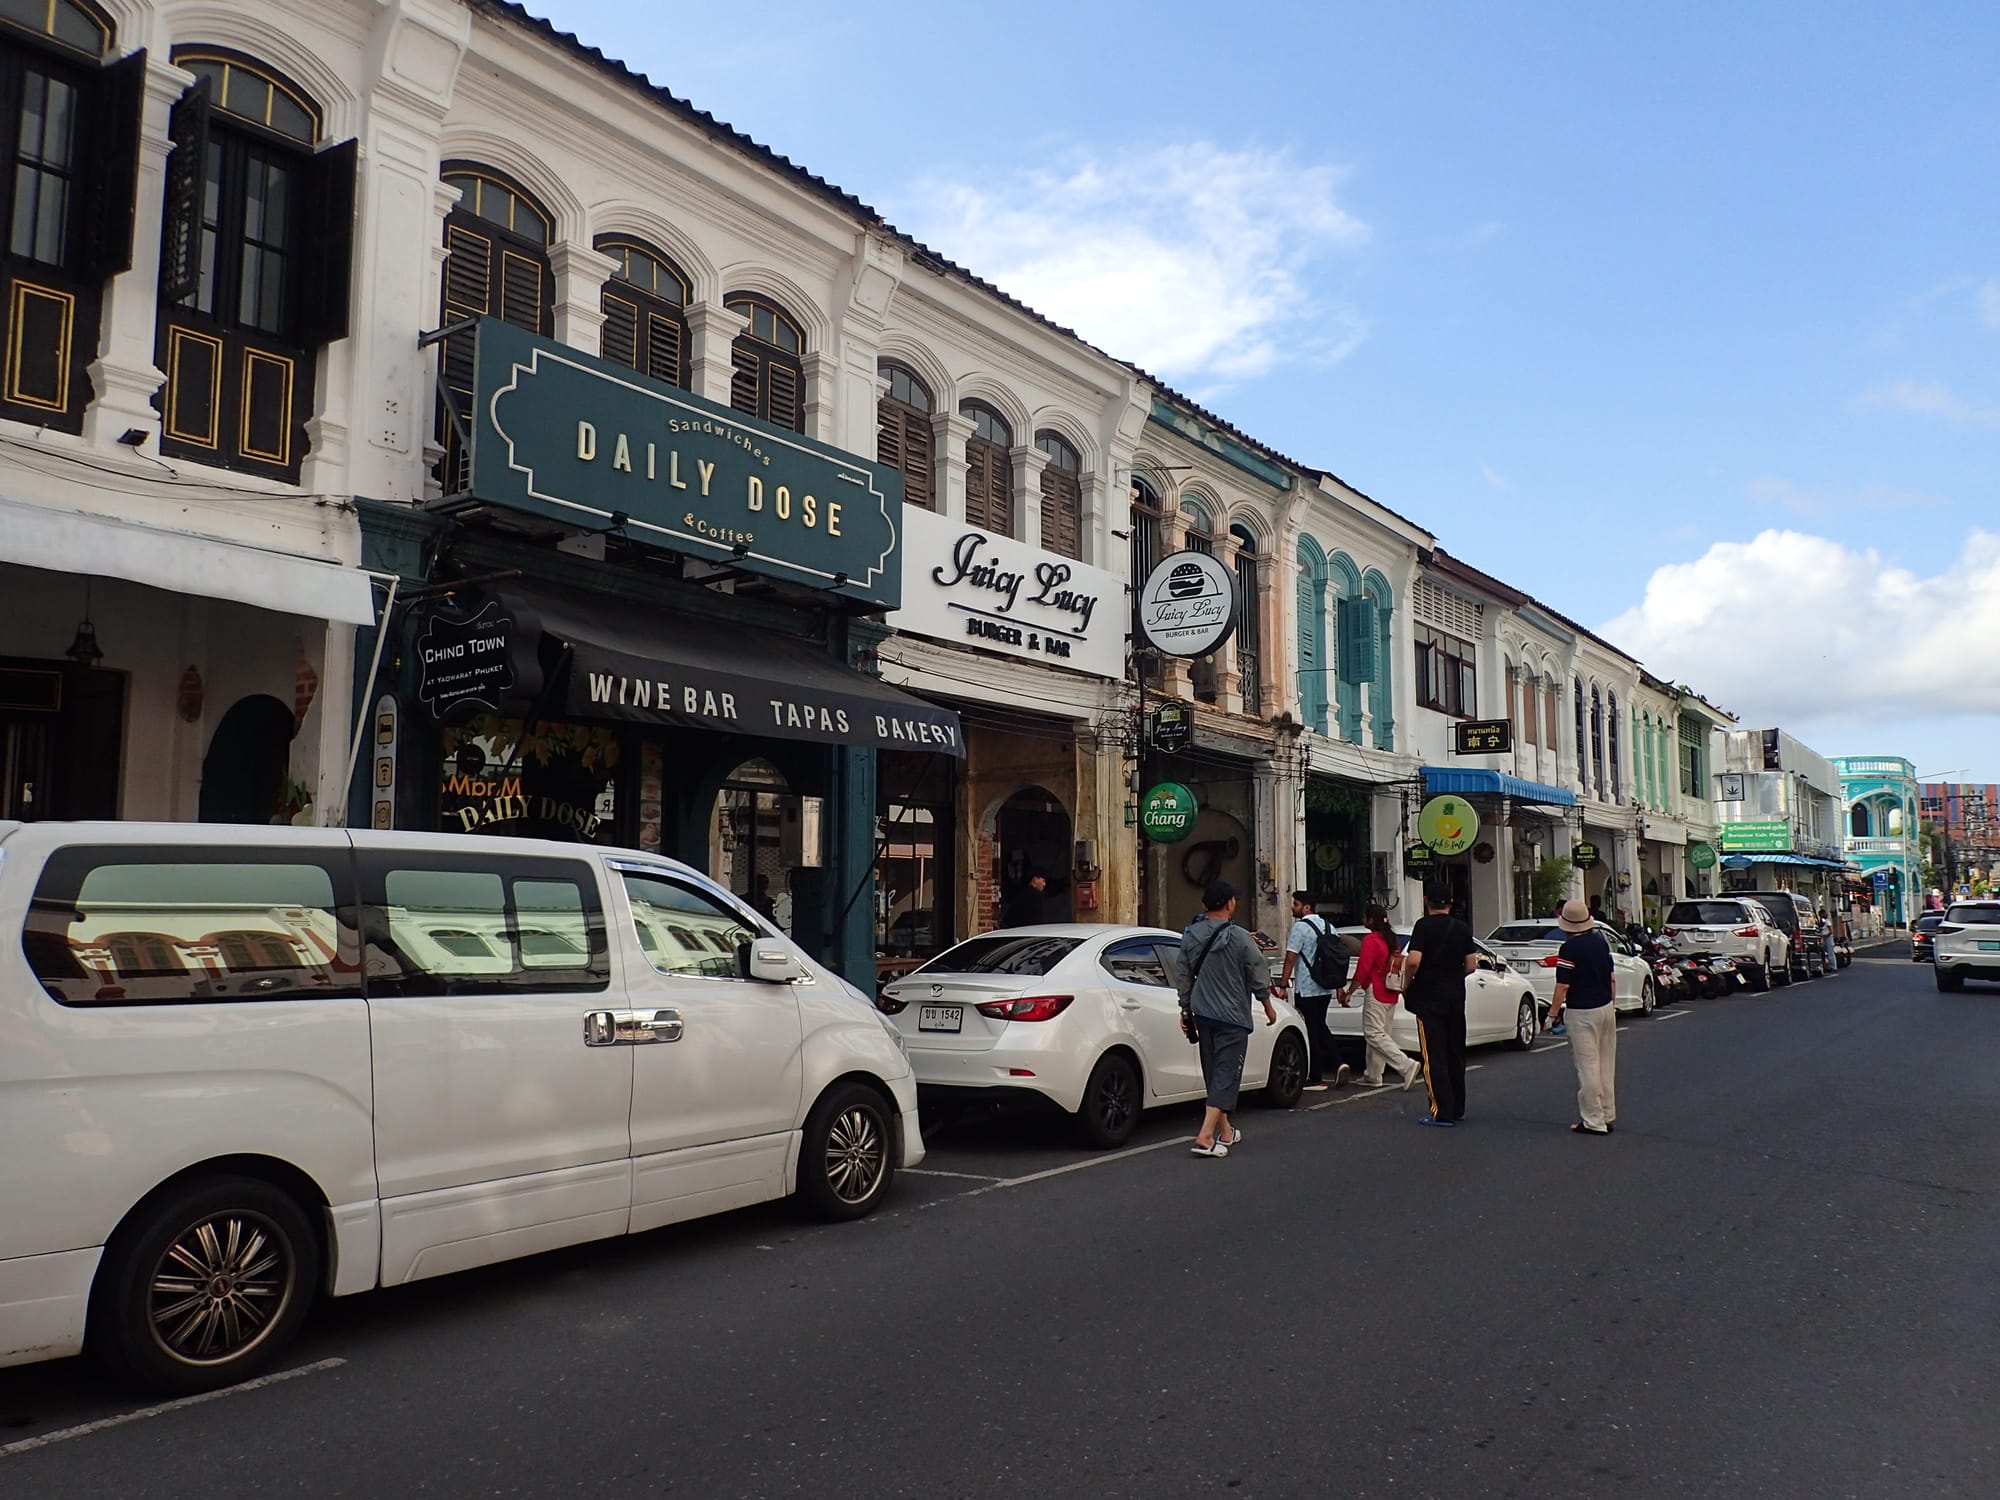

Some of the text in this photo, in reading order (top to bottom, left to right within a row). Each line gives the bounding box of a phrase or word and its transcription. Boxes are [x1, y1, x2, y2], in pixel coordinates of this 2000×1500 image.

[668, 418, 771, 466] Sandwiches
[577, 420, 842, 537] DAILY DOSE
[932, 533, 1098, 633] Juicy Lucy
[1147, 599, 1225, 626] Juicy Lucy
[425, 636, 505, 663] CHINO TOWN
[967, 618, 1071, 658] BURGER & BAR
[1165, 630, 1190, 638] BURGER
[589, 672, 958, 748] WINE BAR TAPAS BAKERY
[457, 795, 532, 832] DAILY
[541, 797, 602, 839] DOSE
[1144, 811, 1186, 828] Chang
[941, 1009, 960, 1020] 1542
